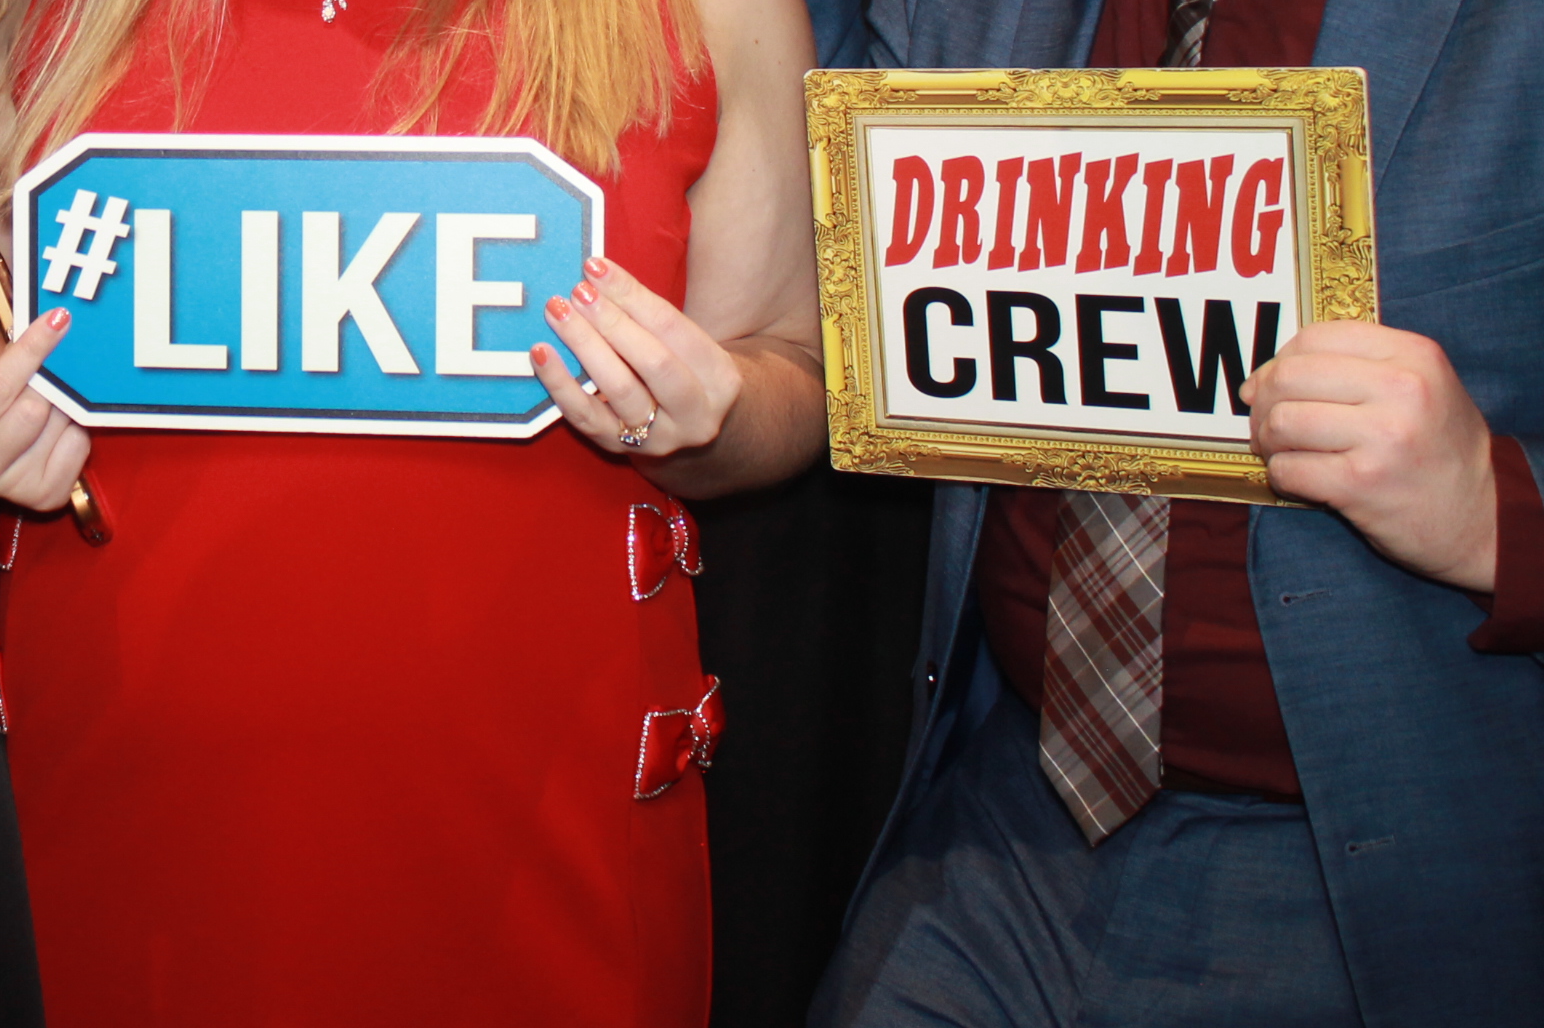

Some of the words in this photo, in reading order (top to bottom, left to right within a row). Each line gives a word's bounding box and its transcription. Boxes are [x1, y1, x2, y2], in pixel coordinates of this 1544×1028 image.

[884, 151, 1285, 279] DRINKING
[41, 188, 536, 377] #LIKE
[902, 286, 1282, 417] CREW
